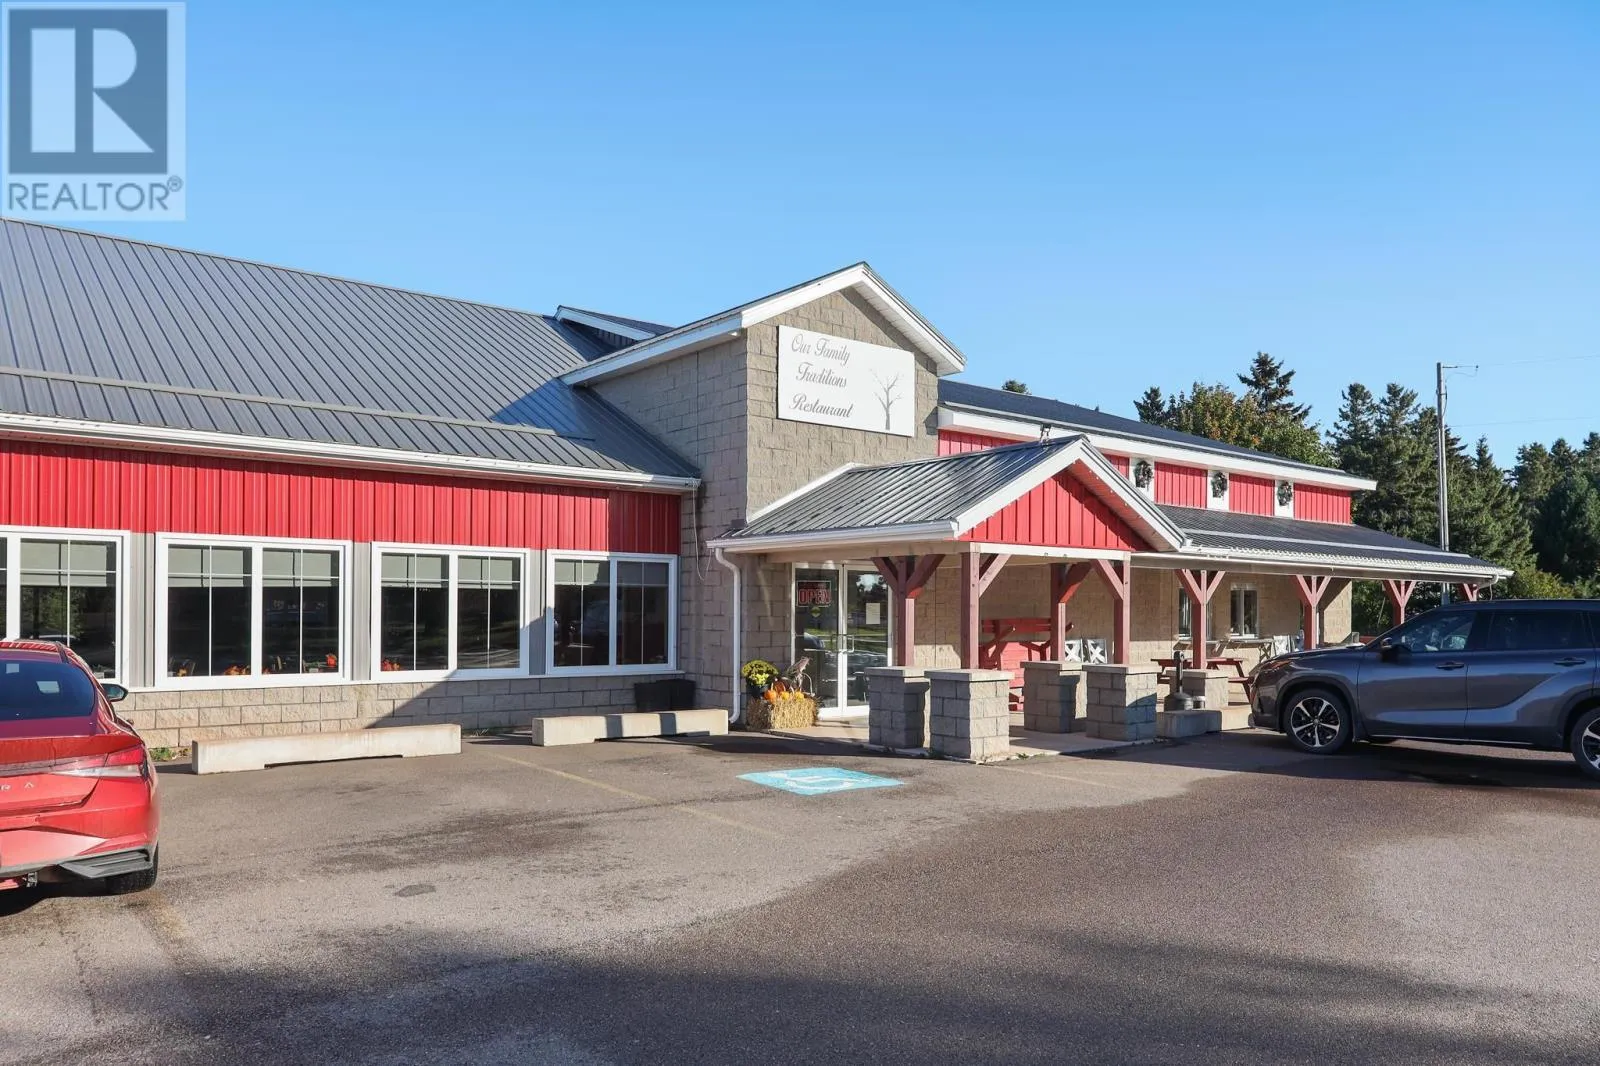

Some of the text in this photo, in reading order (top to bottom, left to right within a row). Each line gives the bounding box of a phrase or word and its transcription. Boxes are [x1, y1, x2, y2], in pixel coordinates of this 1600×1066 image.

[791, 333, 850, 366] Our Family
[795, 361, 847, 388] Traditions
[789, 392, 854, 418] Restaurant
